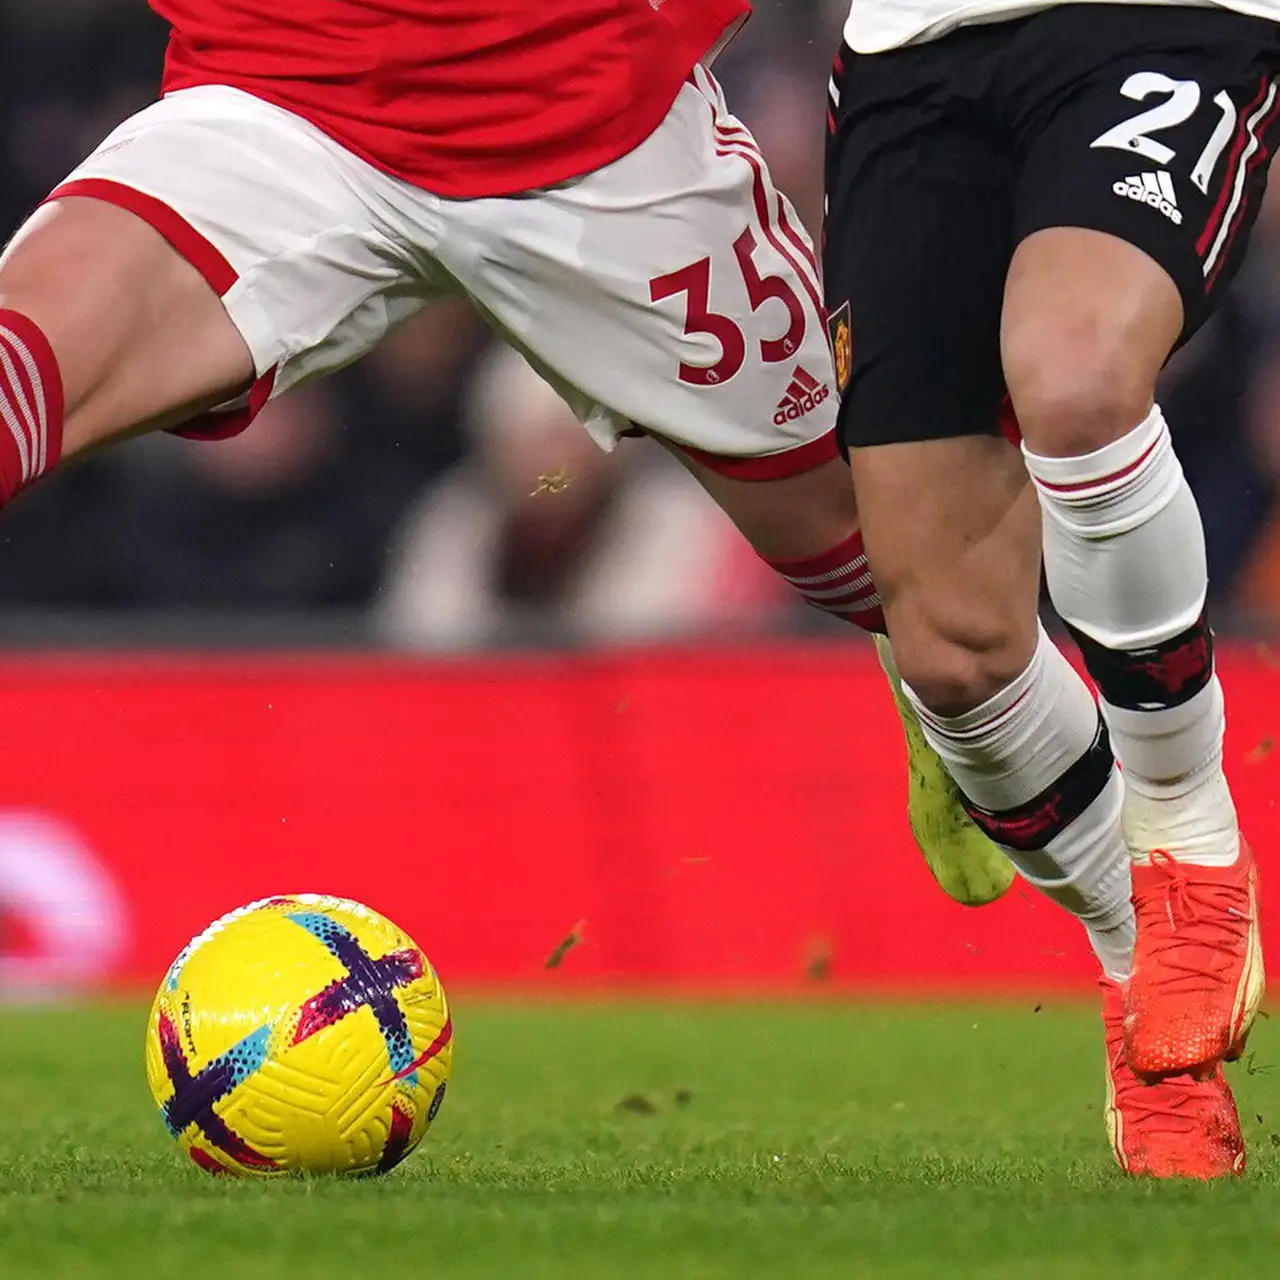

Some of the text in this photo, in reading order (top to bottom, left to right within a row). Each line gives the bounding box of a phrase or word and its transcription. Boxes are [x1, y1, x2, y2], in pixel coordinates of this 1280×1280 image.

[1089, 71, 1236, 195] 21
[1112, 179, 1182, 225] adidas
[648, 225, 807, 387] 35
[773, 382, 830, 426] adidas
